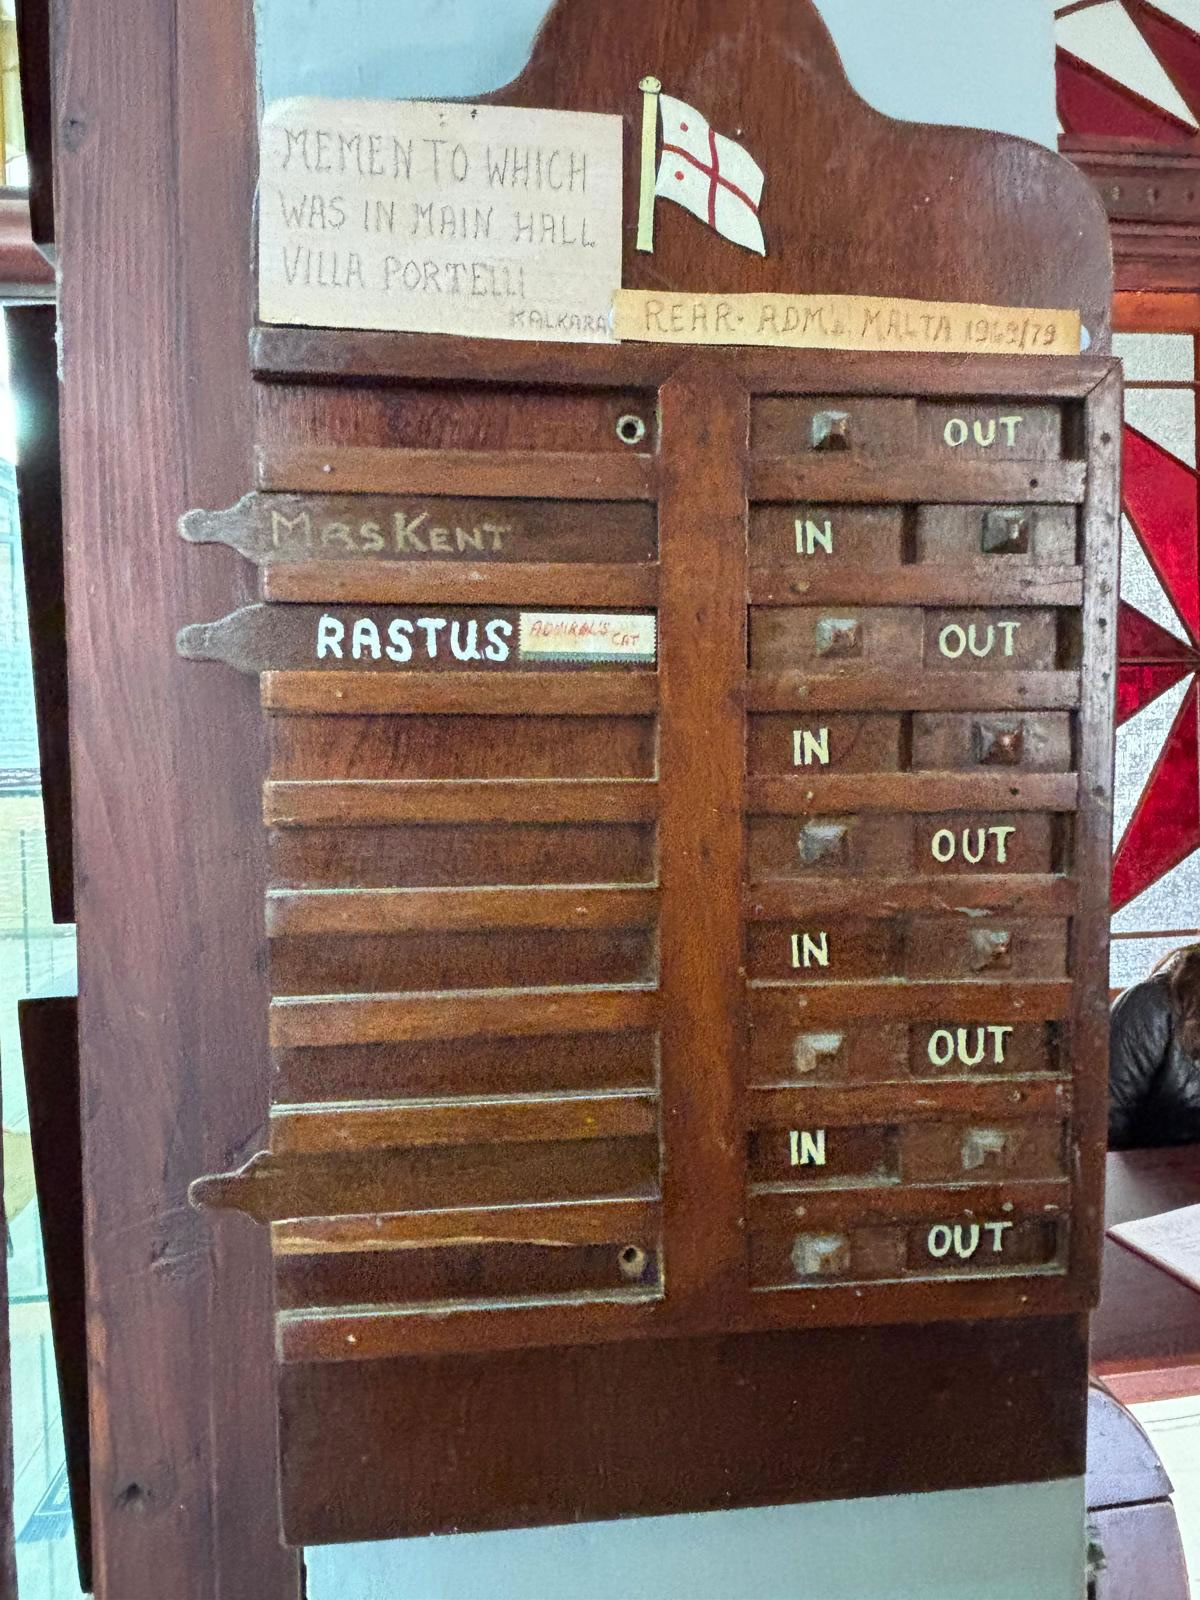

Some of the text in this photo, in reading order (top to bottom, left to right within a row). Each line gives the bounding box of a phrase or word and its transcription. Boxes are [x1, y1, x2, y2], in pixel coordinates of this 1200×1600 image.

[487, 144, 587, 192] WHICH
[278, 189, 597, 247] WAS IN MAIN HALL
[281, 245, 526, 299] VILLA PORTELLI
[511, 309, 607, 335] KALKARA
[861, 307, 952, 343] MALTA
[943, 415, 1024, 448] OUT
[794, 519, 833, 555] IN
[316, 613, 513, 663] RASTUS
[611, 632, 640, 646] CAT
[938, 620, 1022, 659] OUT
[793, 727, 830, 766] IN
[930, 825, 1016, 865] OUT
[791, 931, 830, 969] IN
[927, 1025, 1013, 1067] OUT
[789, 1129, 826, 1166] IN
[927, 1221, 1013, 1259] OUT
